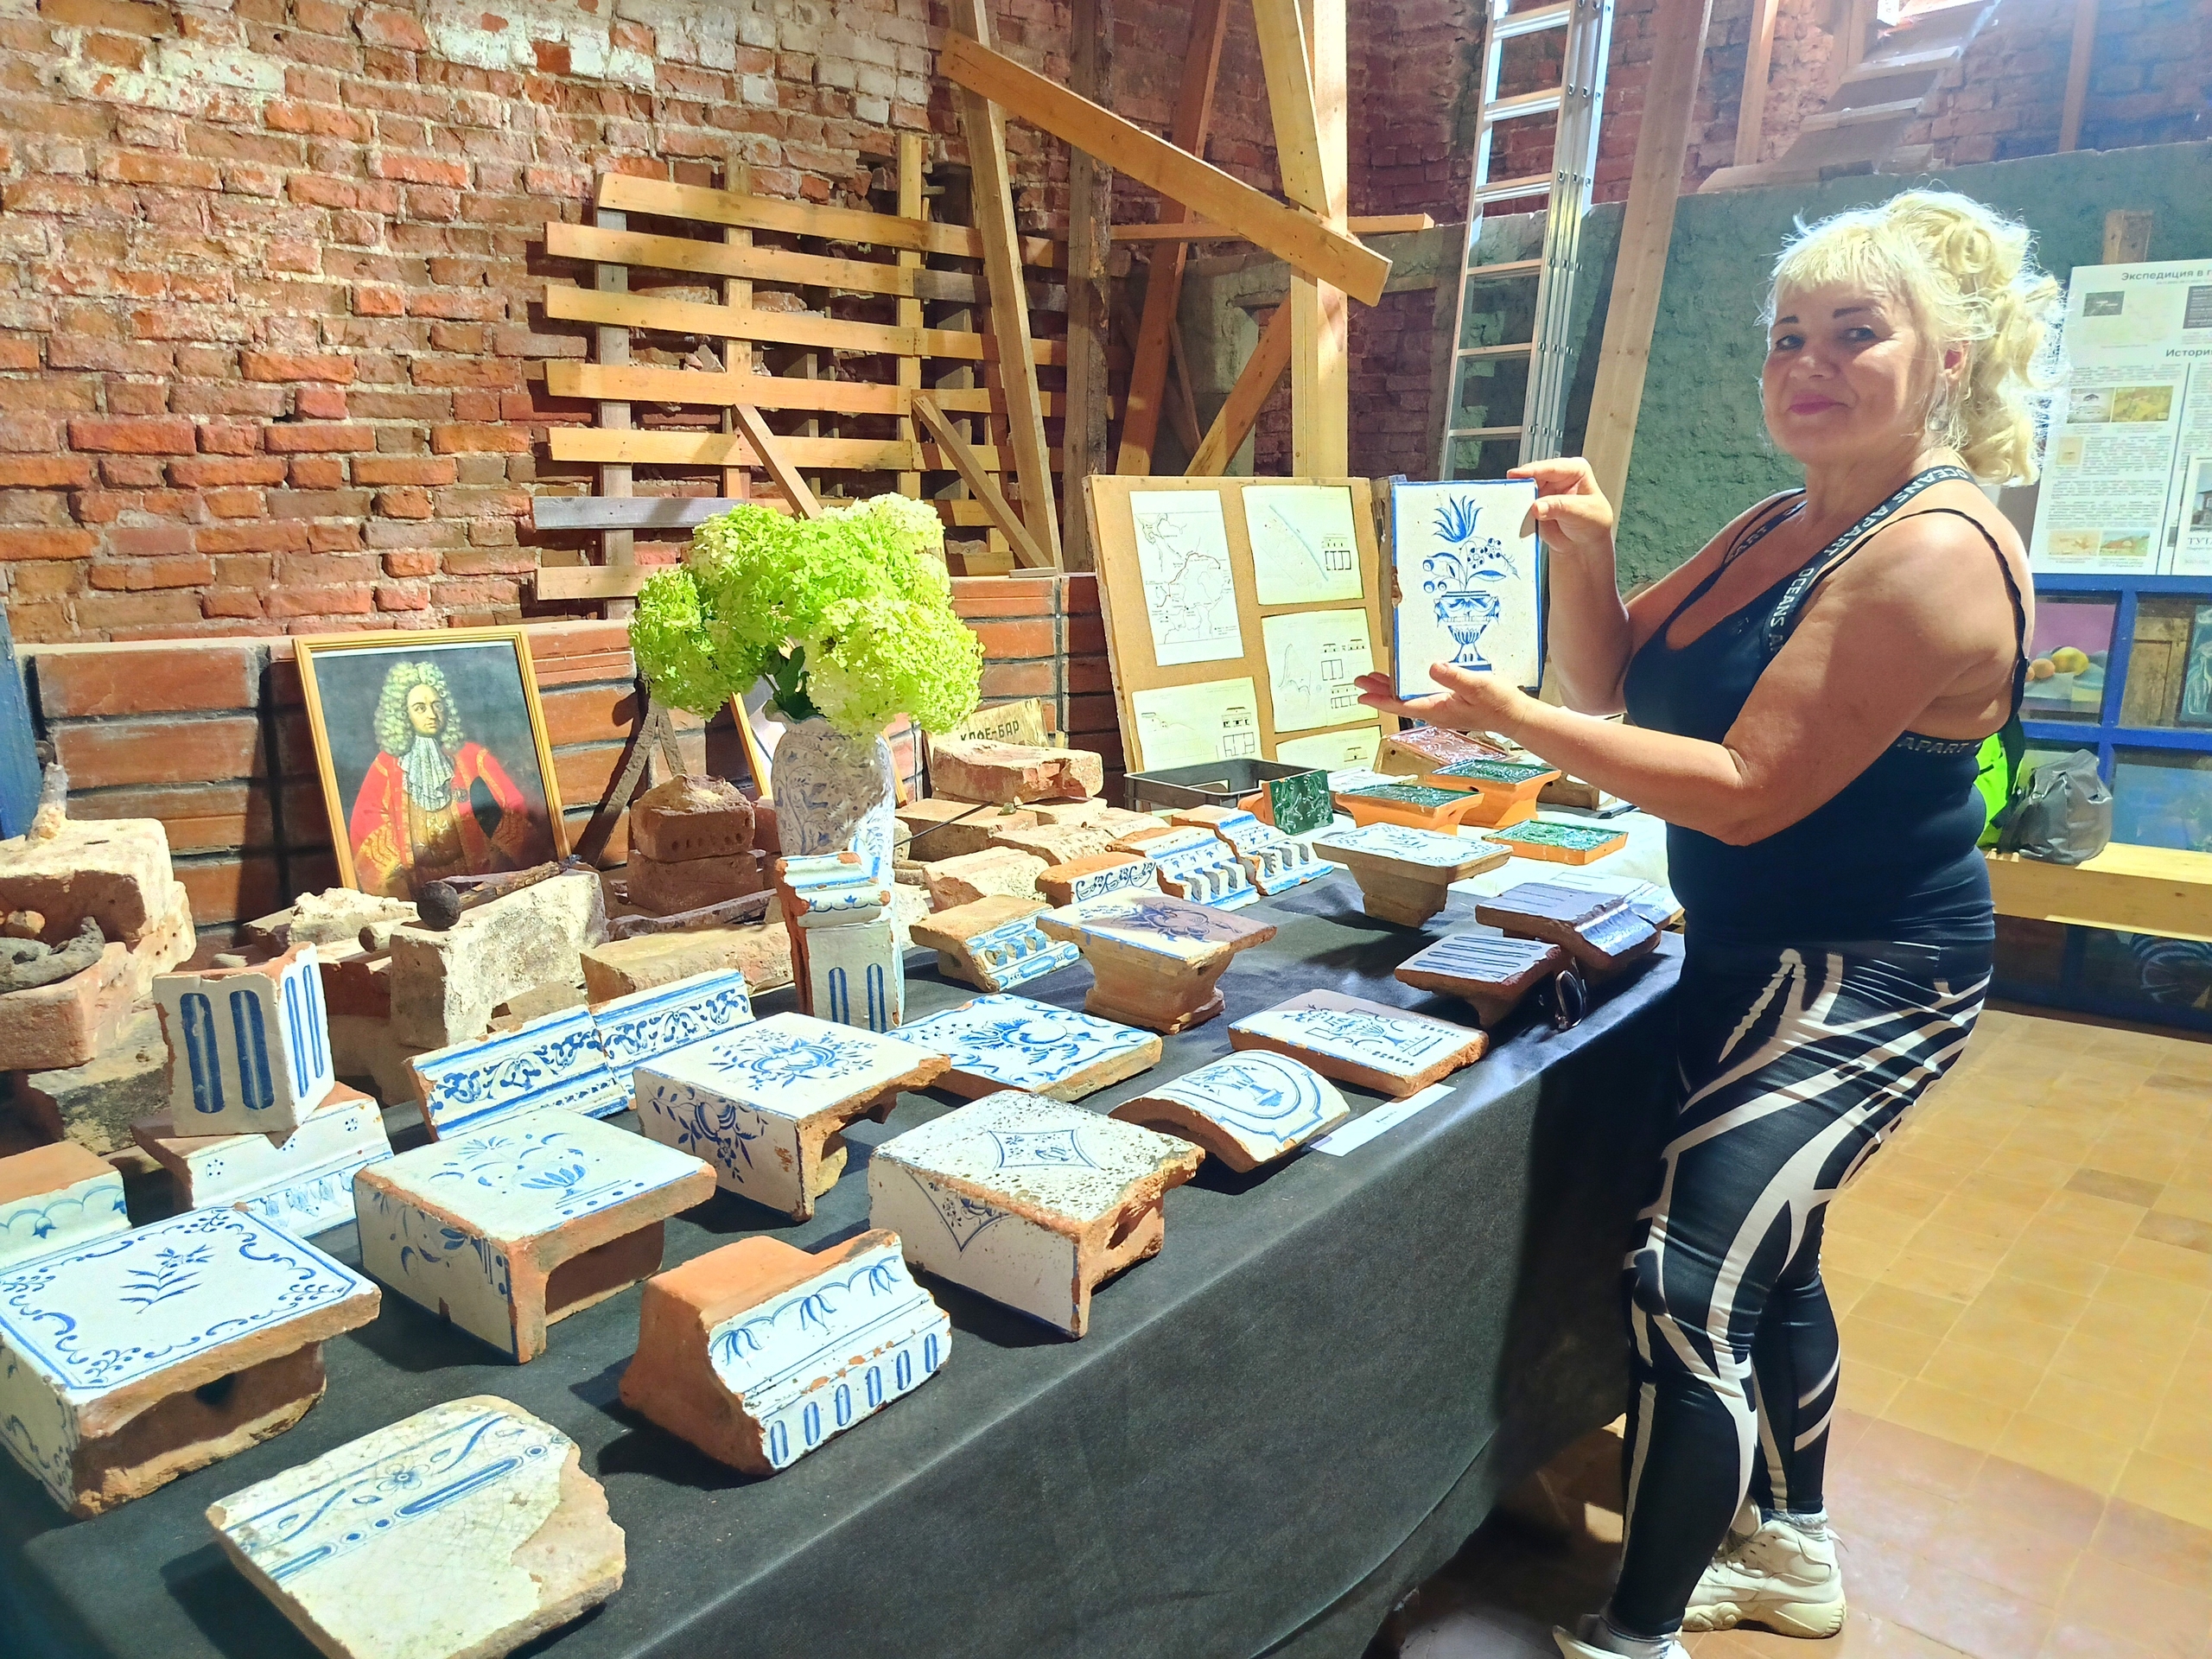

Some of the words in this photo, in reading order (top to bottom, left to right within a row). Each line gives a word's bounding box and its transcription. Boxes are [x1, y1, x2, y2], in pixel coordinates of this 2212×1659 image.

[2121, 270, 2194, 281] Экспедиция
[2165, 348, 2212, 359] Истори
[1892, 467, 1968, 504] OCEANS
[1824, 505, 1889, 556] APART
[1770, 567, 1815, 628] OCEANS
[1897, 736, 1969, 753] APART
